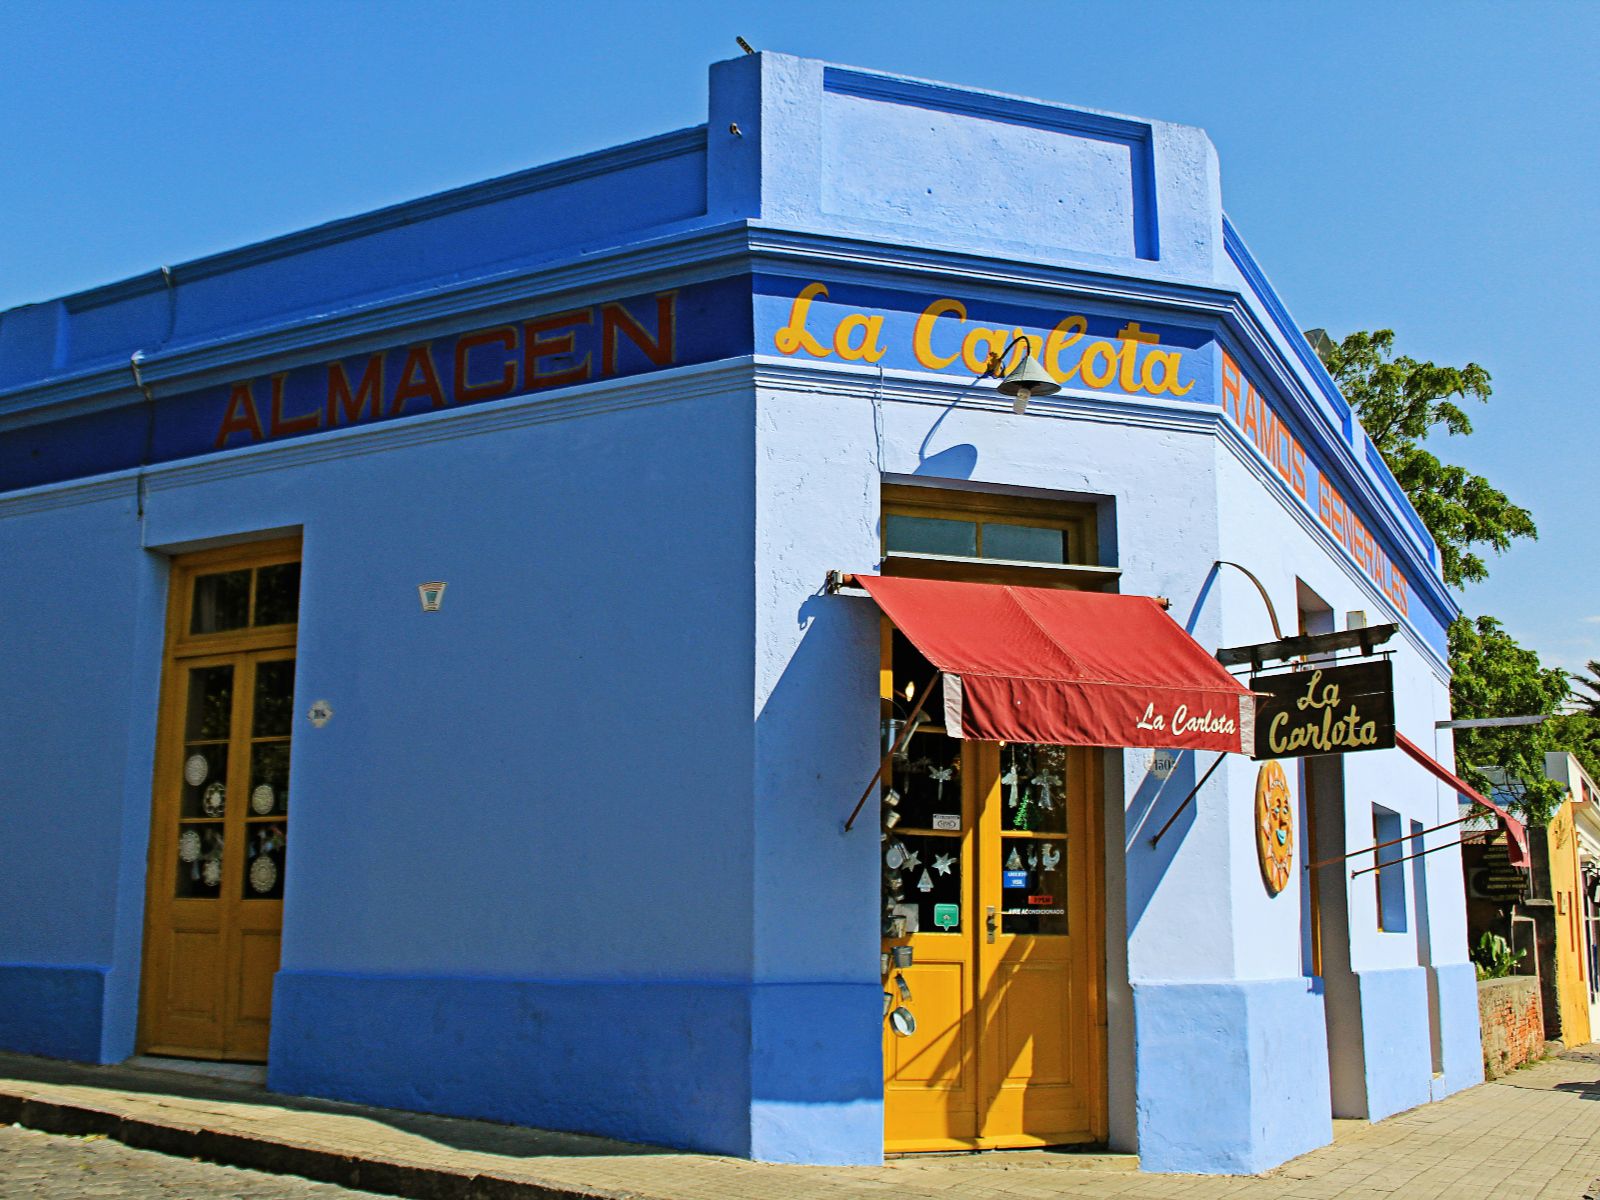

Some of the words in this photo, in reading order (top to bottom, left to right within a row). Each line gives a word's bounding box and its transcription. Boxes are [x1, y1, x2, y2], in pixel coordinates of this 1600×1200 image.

[214, 289, 679, 449] ALMACEN
[773, 282, 887, 364] La
[912, 298, 1197, 397] Carlota
[1221, 348, 1307, 502] RAMOS
[1318, 469, 1409, 619] GENERALES
[1136, 702, 1166, 731] La
[1171, 704, 1236, 735] Carlota
[1269, 705, 1378, 753] Carlota
[1296, 669, 1341, 711] La
